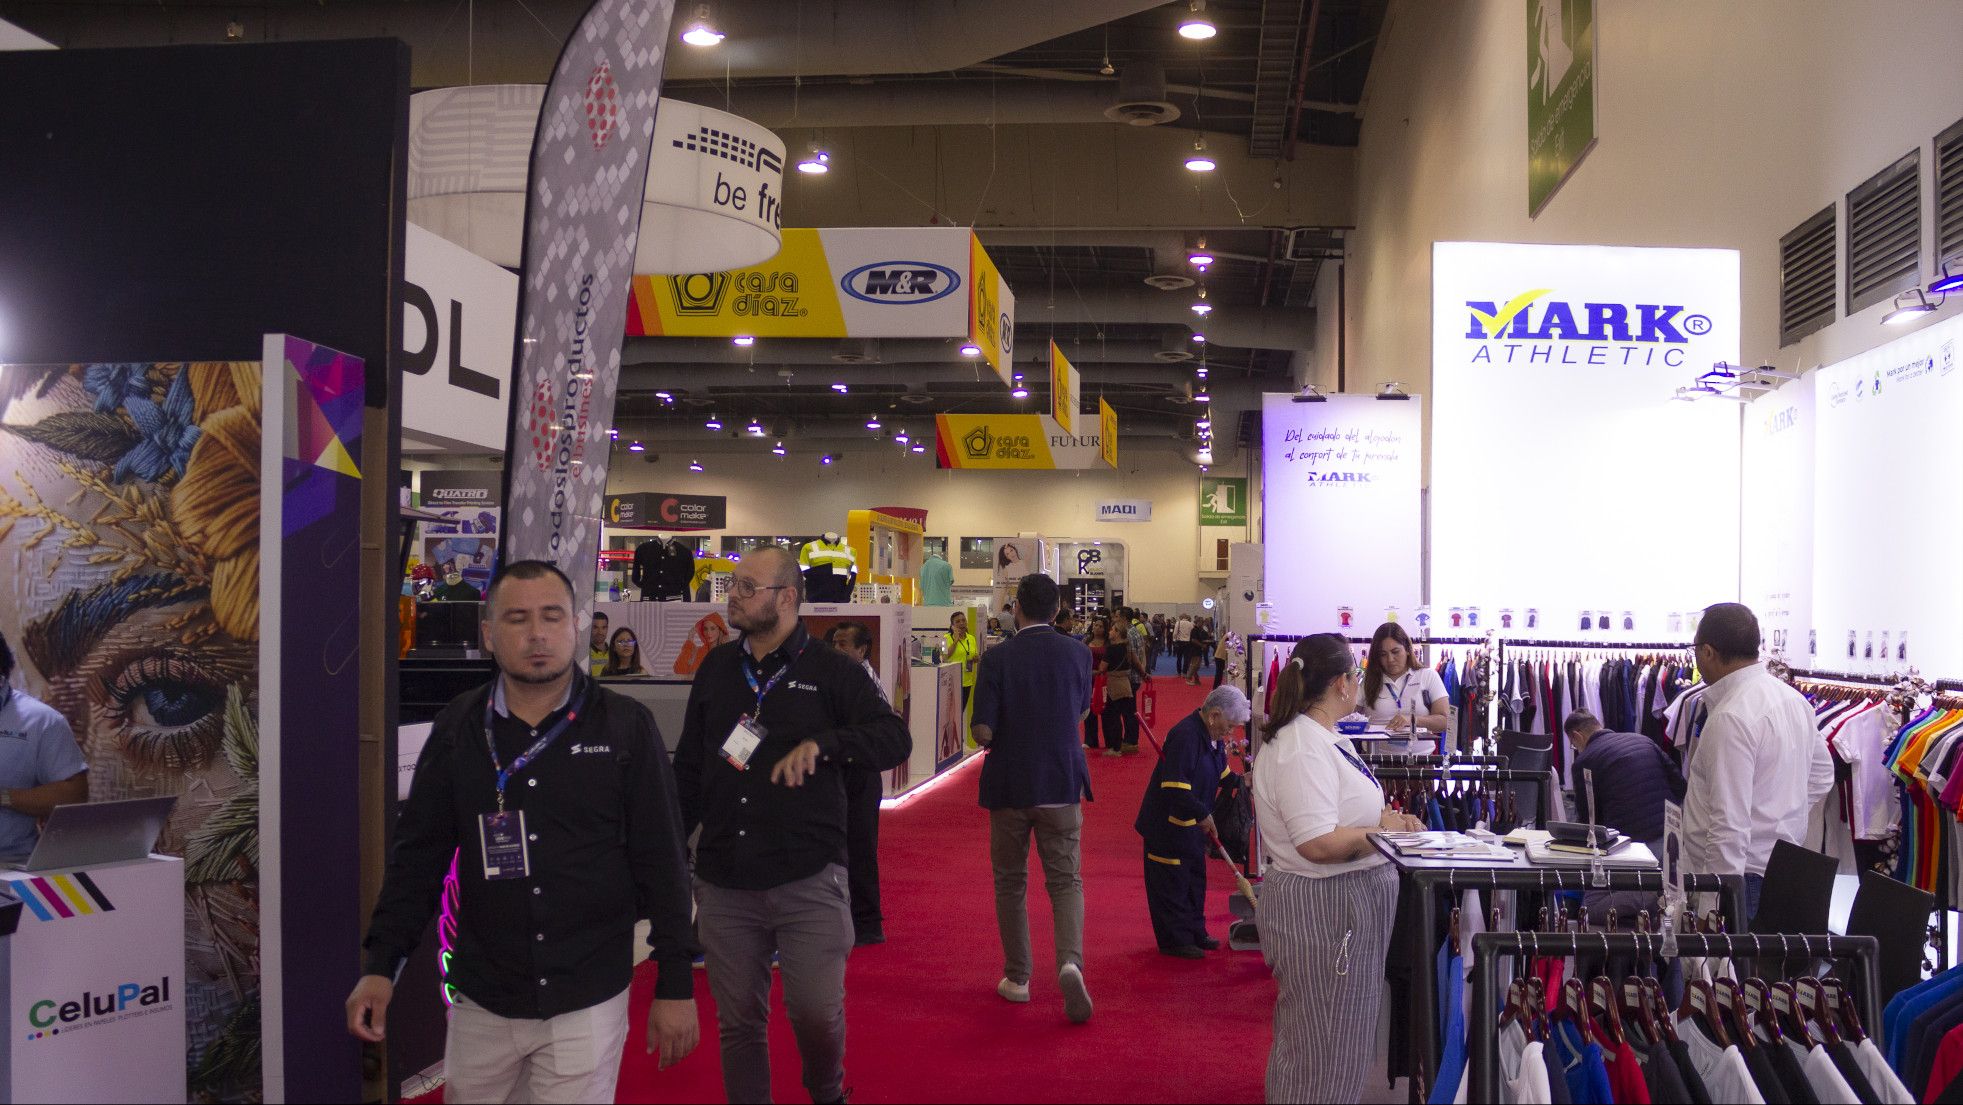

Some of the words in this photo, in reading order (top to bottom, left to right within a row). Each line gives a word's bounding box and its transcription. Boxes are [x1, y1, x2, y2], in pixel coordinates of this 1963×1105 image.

[713, 171, 747, 211] be
[735, 271, 799, 293] casa
[864, 269, 937, 296] M&R
[1471, 344, 1686, 367] ATHLETIC
[1284, 428, 1303, 443] Del
[1307, 427, 1341, 441] cuidado
[1345, 428, 1360, 443] del
[1284, 446, 1295, 462] al
[1299, 447, 1334, 466] confort
[1336, 446, 1348, 460] de
[680, 503, 706, 512] color
[680, 512, 706, 520] make
[797, 683, 818, 692] SEGRA
[583, 745, 610, 753] SEGRA
[28, 976, 170, 1029] CeluPal
